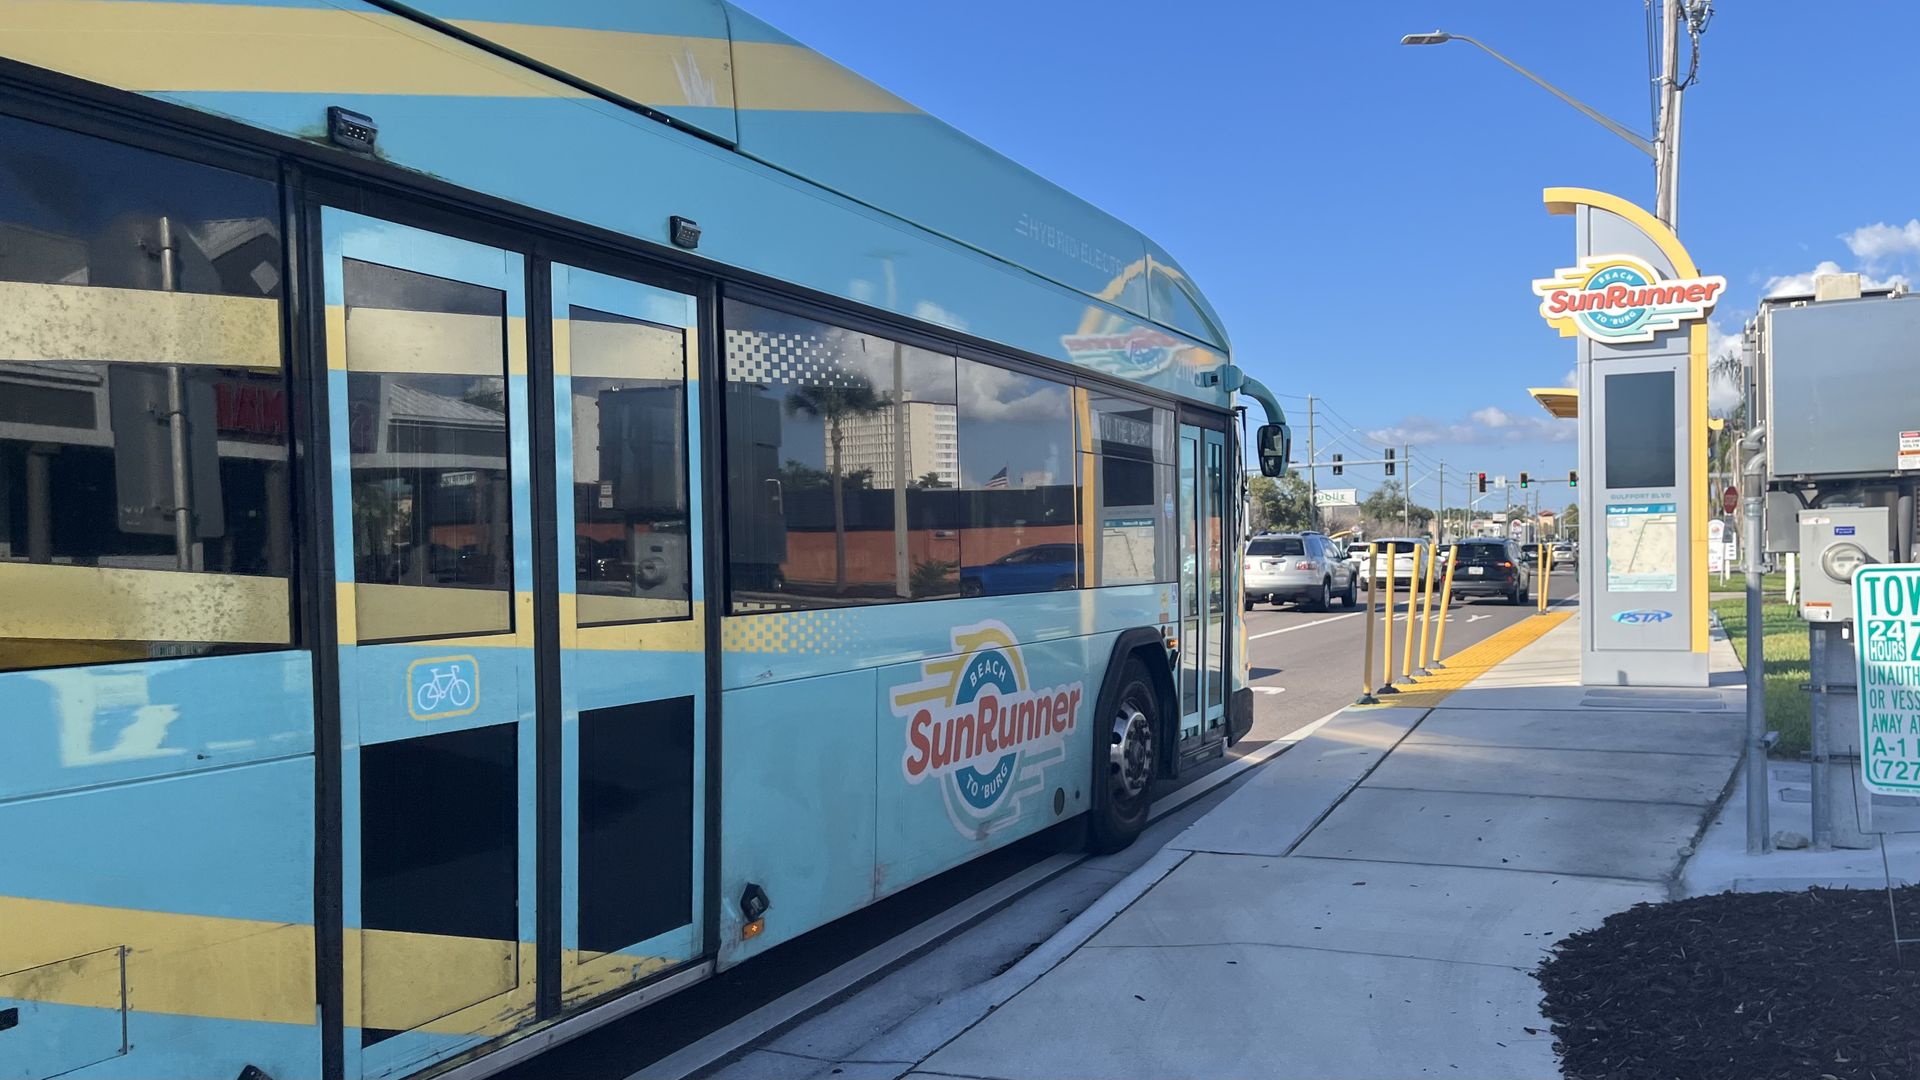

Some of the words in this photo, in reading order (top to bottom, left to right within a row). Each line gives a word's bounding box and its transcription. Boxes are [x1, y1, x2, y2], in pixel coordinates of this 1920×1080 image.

[1598, 271, 1635, 284] BEACH
[1549, 282, 1720, 313] SunRunner
[1596, 314, 1607, 323] TO
[1316, 492, 1345, 501] ublix
[1618, 612, 1663, 623] PSTA
[1869, 621, 1904, 641] 24
[1870, 641, 1905, 661] HOURS
[969, 659, 1008, 688] BEACH
[1870, 689, 1885, 709] OR
[906, 687, 1081, 776] SunRunner
[1872, 713, 1903, 734] AWAY
[1872, 736, 1905, 757] A-1
[965, 773, 979, 797] TO
